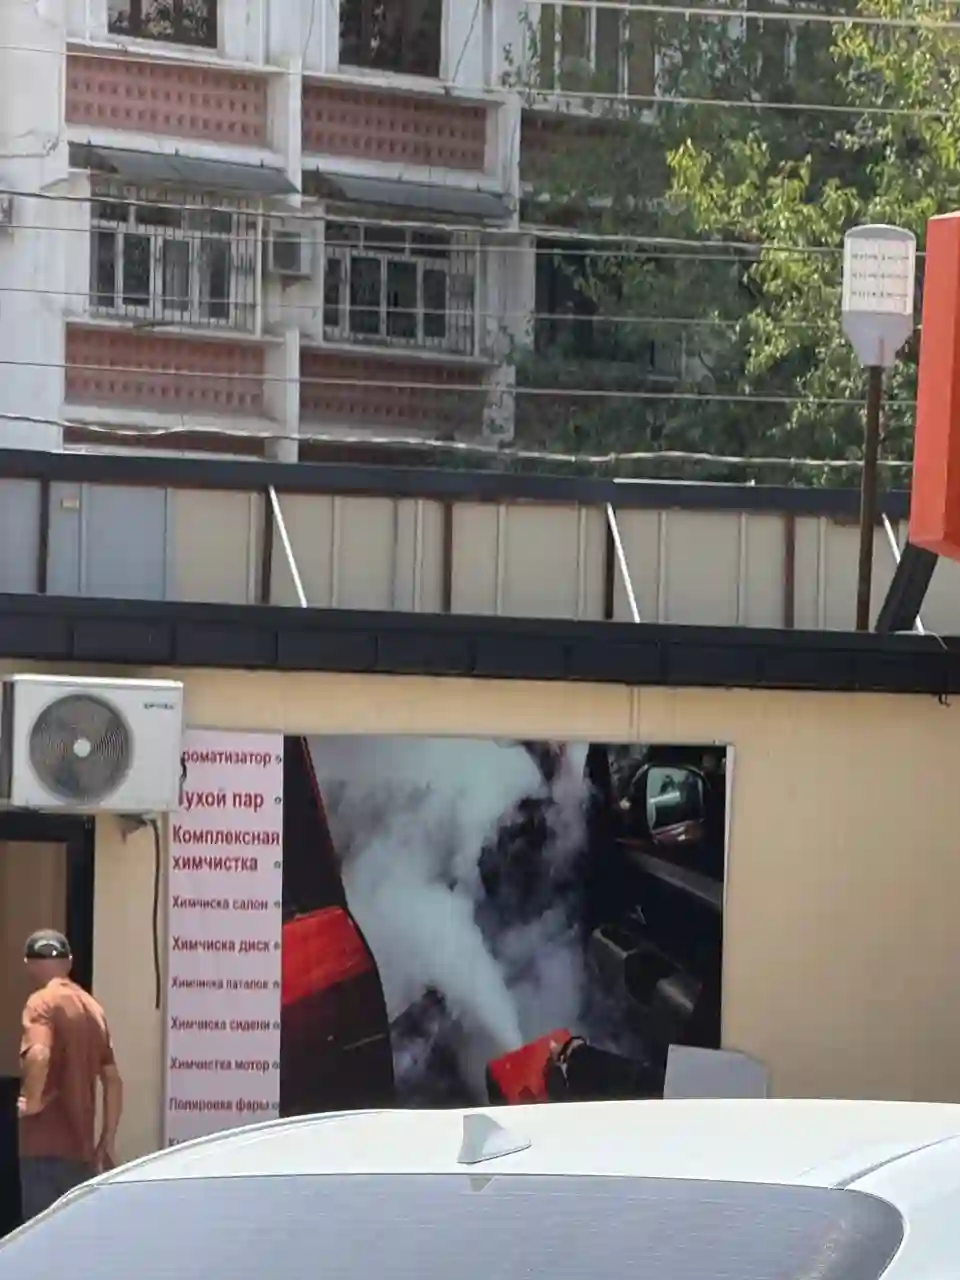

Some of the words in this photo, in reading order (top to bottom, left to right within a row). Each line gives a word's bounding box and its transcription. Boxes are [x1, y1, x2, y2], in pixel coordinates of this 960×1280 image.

[183, 750, 272, 768] роматизатор
[185, 787, 226, 812] ухой
[233, 792, 264, 813] пар
[173, 824, 280, 846] Комплексная
[173, 855, 258, 873] химчистка
[235, 1060, 270, 1073] мотор
[236, 1097, 269, 1116] фары
